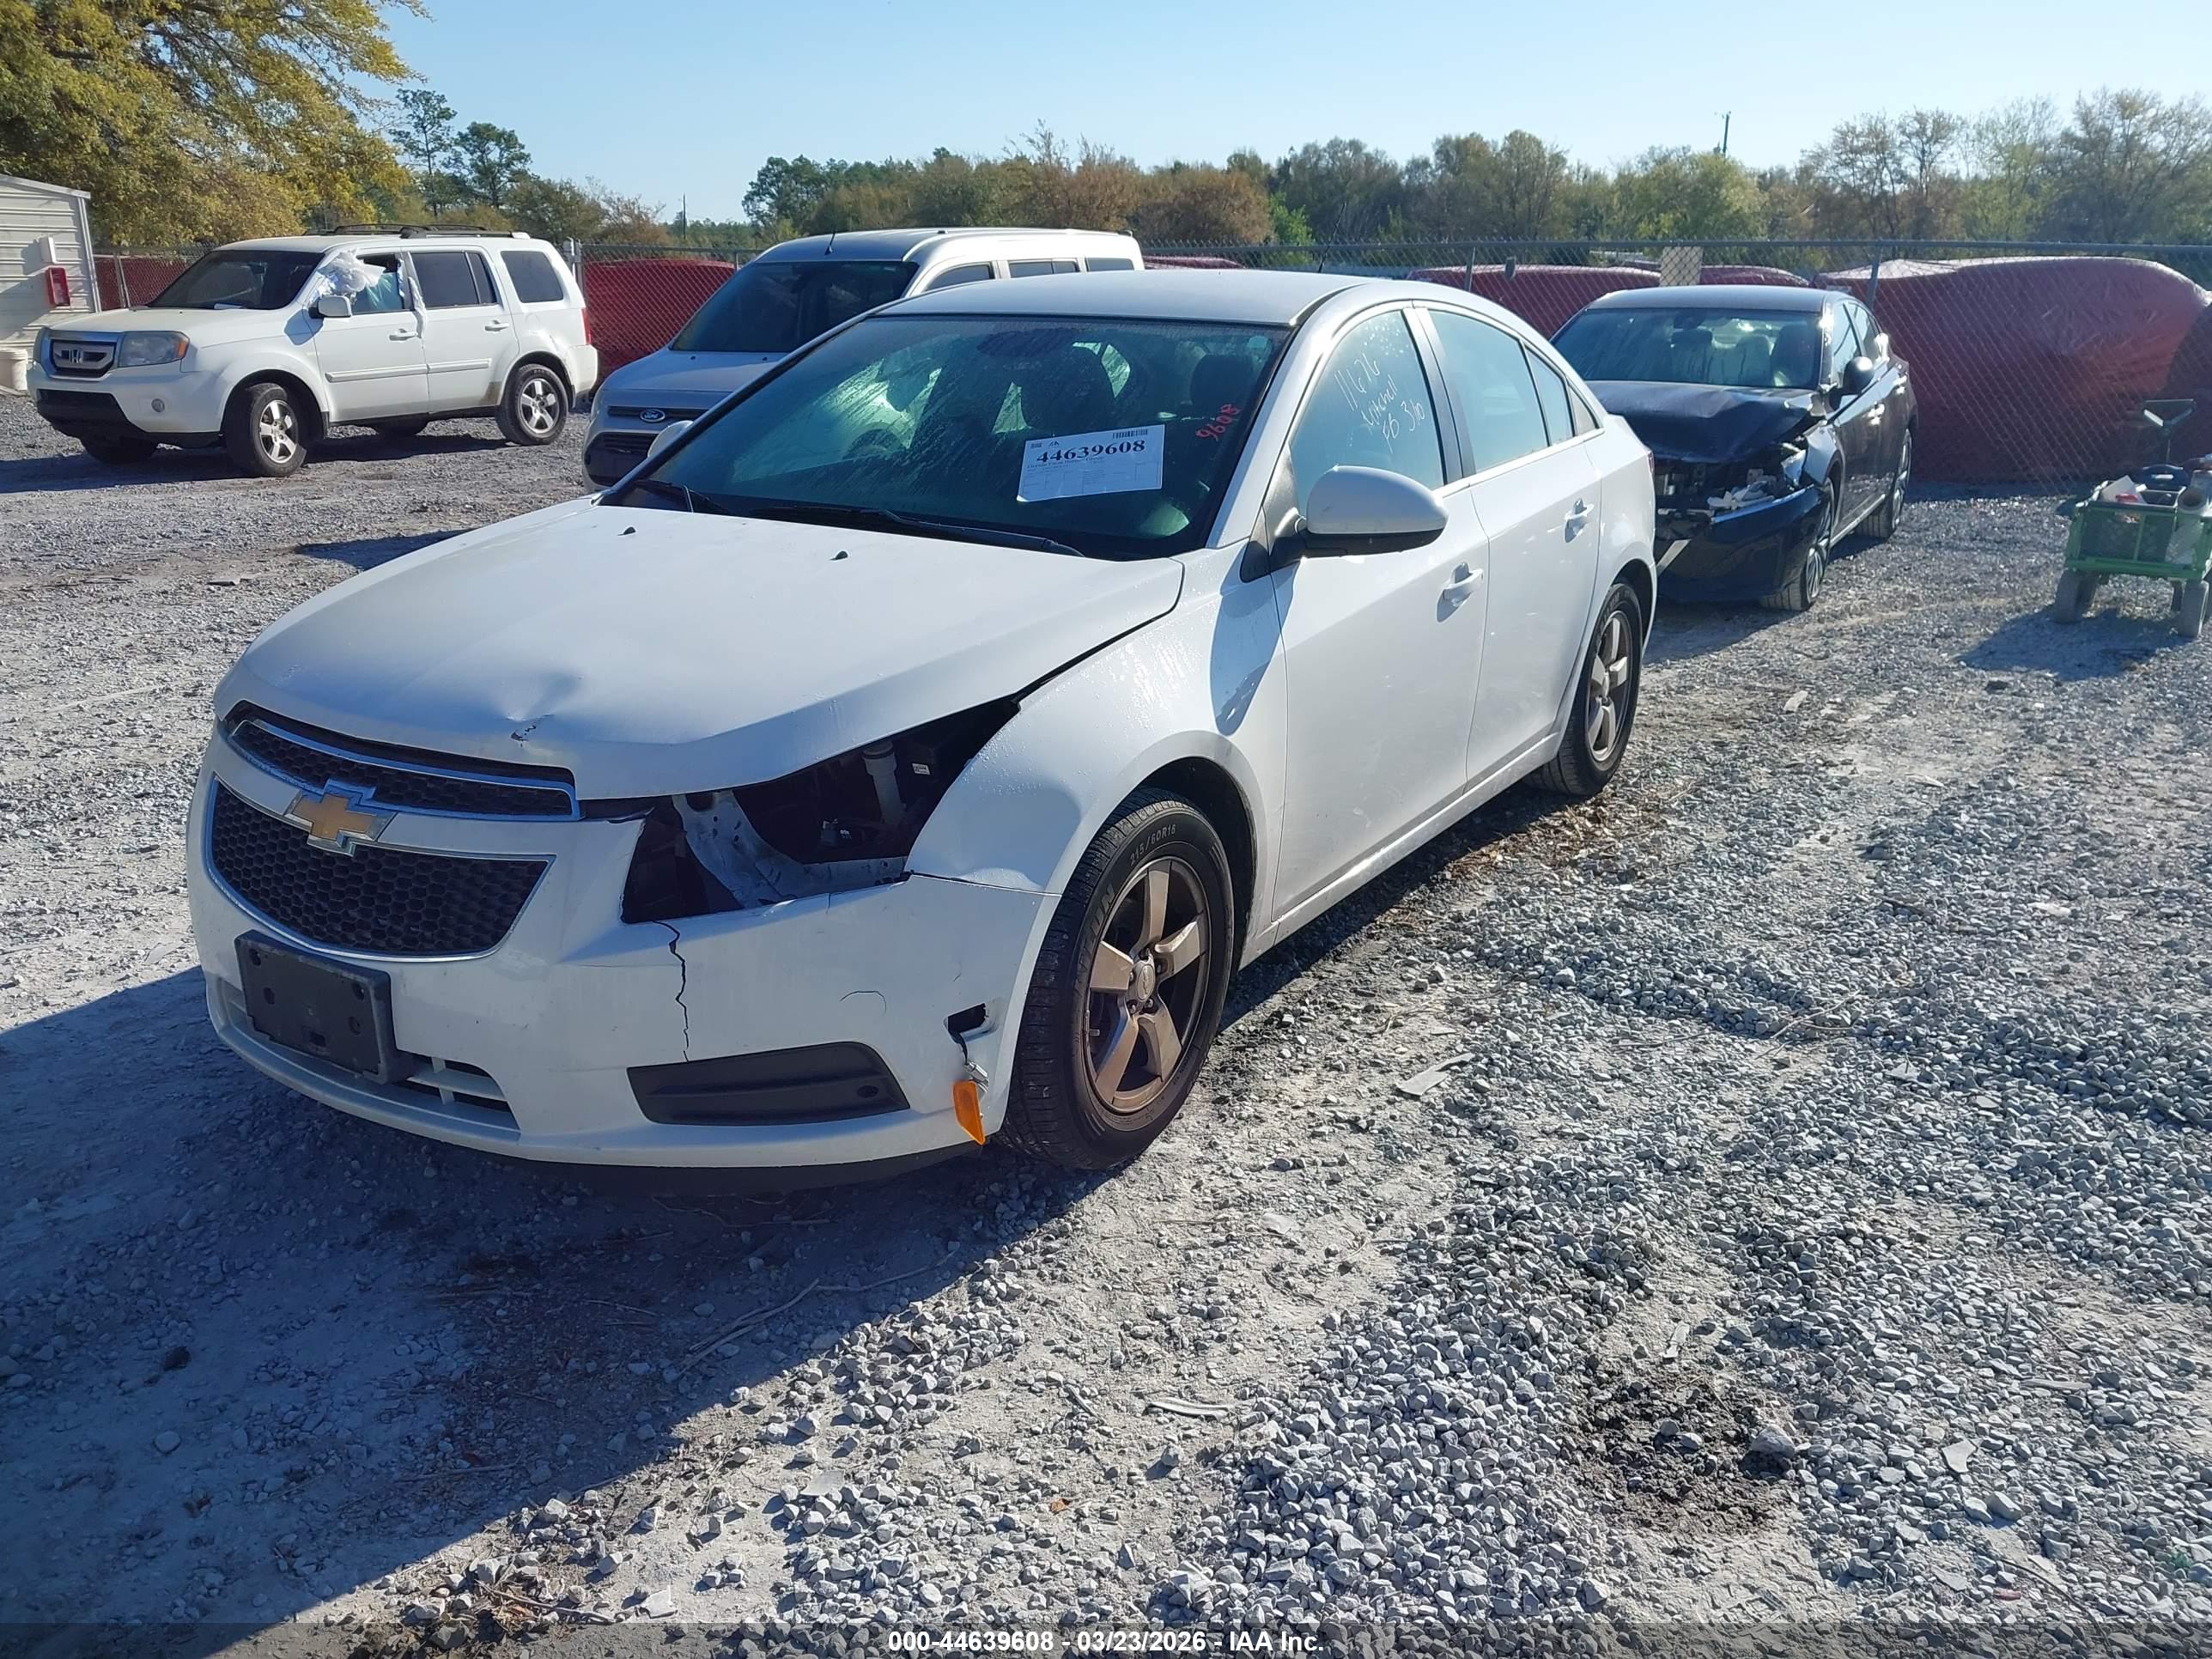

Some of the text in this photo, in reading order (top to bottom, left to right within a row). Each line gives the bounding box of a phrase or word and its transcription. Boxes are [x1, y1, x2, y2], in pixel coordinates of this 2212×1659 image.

[1195, 404, 1241, 442] 9608
[1036, 440, 1146, 463] 44639608
[1130, 823, 1176, 866] 215/60R16
